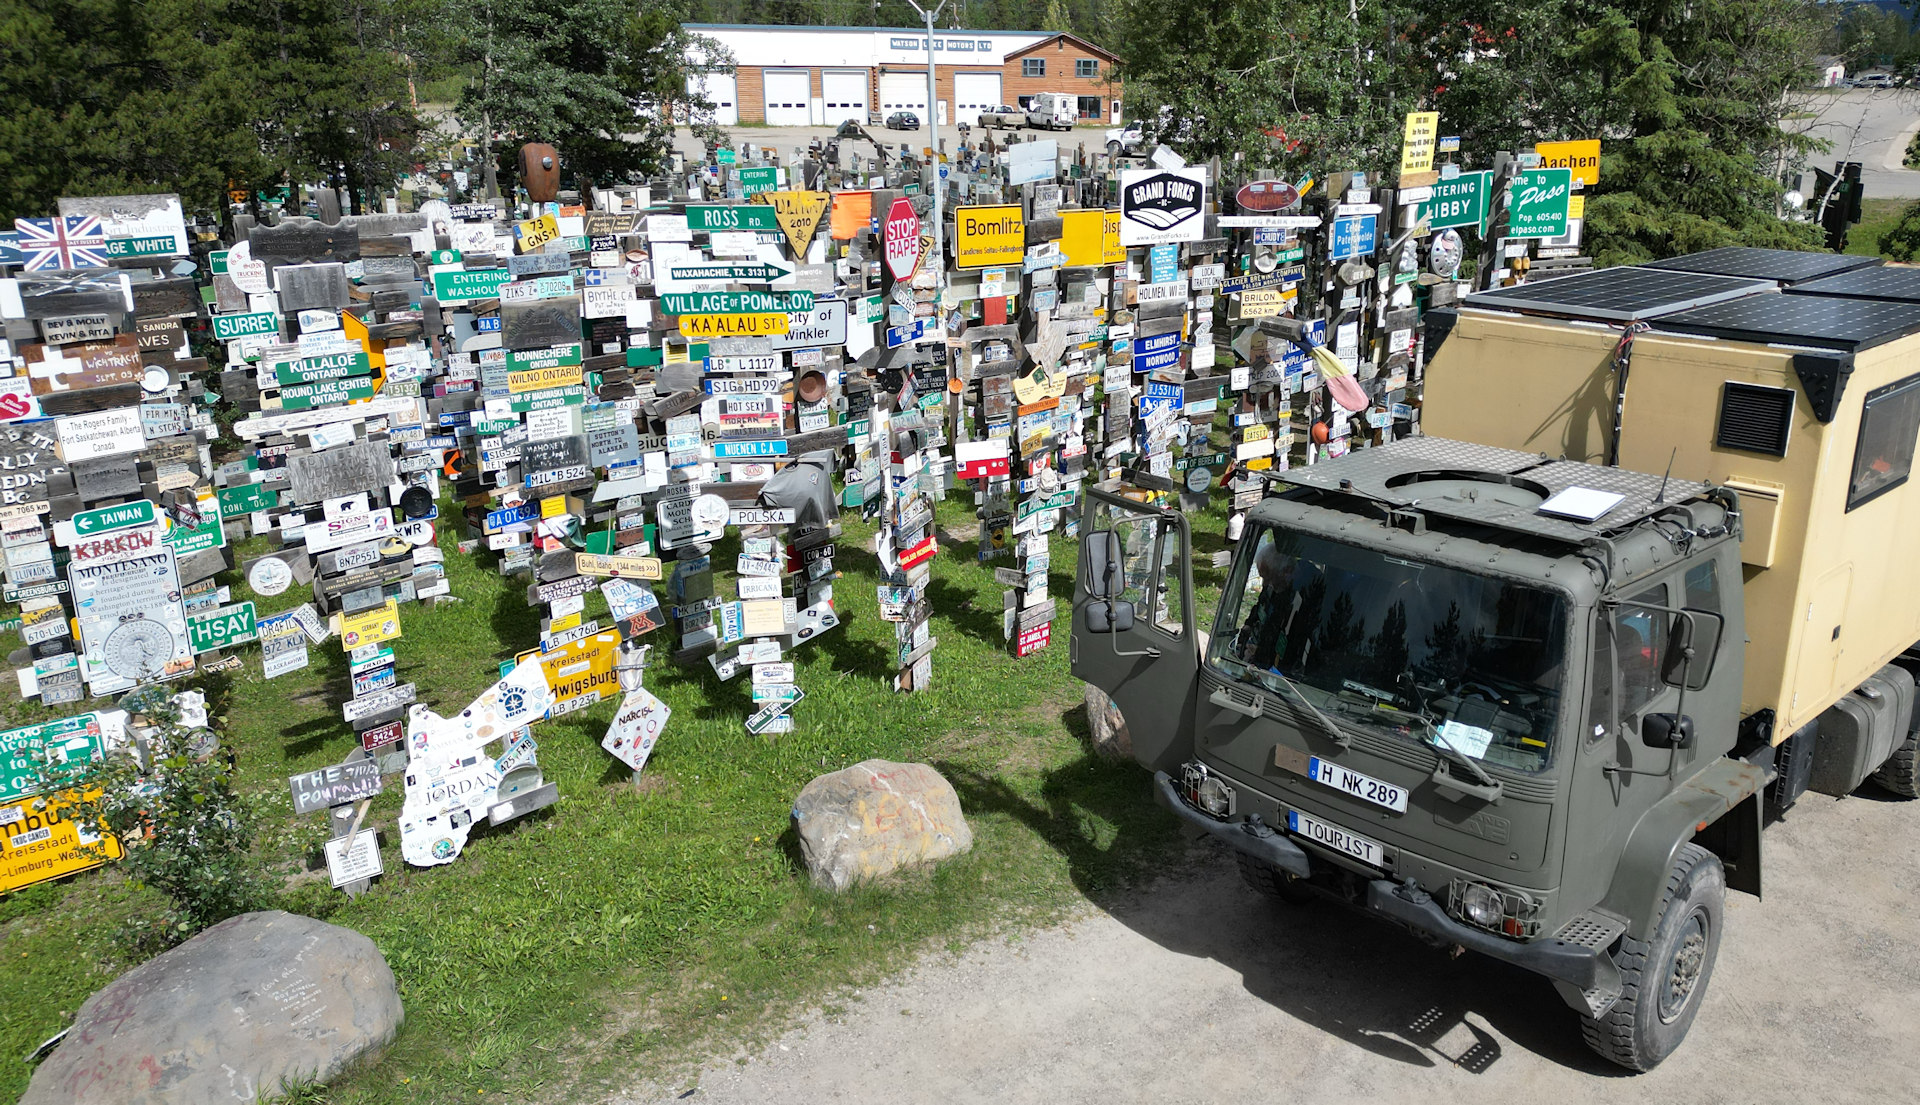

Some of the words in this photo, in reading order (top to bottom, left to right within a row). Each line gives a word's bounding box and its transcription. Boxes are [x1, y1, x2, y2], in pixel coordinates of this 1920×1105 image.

[923, 40, 942, 48] LKE
[947, 41, 973, 49] MOTORS
[1539, 155, 1597, 169] Aachen
[1537, 174, 1546, 184] to
[744, 183, 774, 193] IRKLAND
[1132, 182, 1164, 205] GRAND
[1167, 182, 1195, 203] FORKS
[1518, 183, 1565, 212] Paso
[1426, 200, 1471, 219] LIBBY
[530, 219, 544, 232] 73
[704, 210, 739, 227] ROSS
[749, 218, 763, 227] RD.
[790, 218, 811, 227] 2010
[966, 216, 1022, 236] Bomlitz
[888, 218, 916, 240] STOP
[133, 238, 174, 253] WHITE
[528, 230, 558, 247] GNS-1
[889, 237, 916, 259] RAPE
[453, 273, 510, 284] ENTERING
[673, 268, 733, 278] WAXAHACHIE,
[748, 268, 766, 277] 3131
[768, 268, 778, 276] MI
[1202, 267, 1215, 276] LOCAL
[1223, 277, 1248, 288] GLACIER
[1250, 272, 1275, 283] BREWING
[1277, 267, 1302, 279] COMPANY
[1194, 276, 1211, 287] TRAFFIC
[1139, 286, 1167, 300] HOLMEN,
[1169, 285, 1177, 296] WI
[1244, 294, 1275, 302] BRILON
[665, 296, 730, 313] VILLAGE
[48, 320, 65, 329] DEV
[76, 317, 105, 326] MOLLY
[691, 316, 757, 333] KA'ALAU
[764, 318, 776, 330] ST
[786, 311, 809, 325] City
[819, 309, 833, 321] of
[142, 321, 179, 331] SANDRA
[218, 315, 276, 336] SURREY
[49, 330, 76, 342] KEVIN
[88, 328, 110, 337] RITA
[784, 328, 830, 341] Winkler
[1145, 335, 1176, 350] ELMHIRST
[514, 347, 572, 362] BONNECHERE
[1146, 352, 1175, 367] NORWOOD
[289, 355, 357, 373] KILLALOE
[530, 359, 559, 368] ONTARIO
[710, 358, 724, 370] LB
[748, 358, 774, 369] 1117
[302, 368, 348, 381] ONTARIO
[510, 372, 540, 384] WILNO
[543, 367, 580, 380] ONTARIO
[282, 386, 313, 399] ROUND
[315, 384, 336, 394] LAKE
[338, 378, 372, 392] CENTER
[532, 390, 564, 400] MADAWASKA
[565, 386, 583, 395] VALLEY
[713, 381, 737, 393] SIG
[744, 380, 760, 392] HD
[762, 379, 777, 391] 99
[309, 392, 349, 406] ONTARIO
[531, 398, 565, 409] ONTARIO
[146, 410, 161, 418] FIR
[728, 402, 742, 412] HOT
[746, 402, 764, 412] SEXY
[70, 422, 82, 431] The
[83, 419, 106, 430] Rogers
[107, 416, 128, 427] Family
[478, 422, 510, 433] LUMBY
[62, 435, 74, 444] Fort
[75, 427, 119, 443] Saskatchewan,
[120, 424, 141, 434] Alberta
[595, 430, 625, 439] SUTTON'S
[92, 441, 115, 452] Canada
[592, 440, 611, 448] NORTH
[724, 442, 757, 456] NUENEN
[531, 474, 551, 485] MIL
[557, 470, 563, 480] B
[566, 468, 585, 478] 524
[16, 506, 35, 514] 7065
[100, 507, 143, 525] TAIWAN
[739, 511, 785, 523] POLSKA
[74, 532, 154, 560] KRAKOW
[189, 534, 214, 546] LIMITS
[78, 553, 168, 579] MONTESANO
[581, 558, 596, 569] Buhl,
[597, 558, 612, 569] Idaho
[616, 562, 629, 571] 1344
[630, 563, 646, 573] miles
[110, 572, 149, 584] designated
[95, 586, 124, 596] heritage
[126, 578, 165, 589] community
[611, 582, 632, 597] ROXY
[101, 593, 130, 604] founded
[132, 588, 155, 597] during
[89, 600, 135, 613] Washington's
[678, 607, 689, 617] MK
[362, 622, 379, 632] GERMANY
[547, 637, 560, 649] LB
[565, 630, 579, 642] TK
[580, 623, 597, 637] 760
[264, 642, 281, 655] 972
[288, 636, 305, 647] KLX
[550, 648, 600, 669] Kreisstadt
[552, 669, 618, 698] dwigsburg
[498, 687, 527, 703] EARTH
[505, 707, 527, 719] IRON
[553, 703, 566, 715] LB
[372, 729, 394, 743] 9424
[499, 756, 515, 773] 425
[517, 739, 533, 755] FMB
[9, 759, 27, 770] to
[292, 768, 341, 792] THE
[425, 769, 498, 806] JORDAN
[1322, 764, 1333, 783] H
[1342, 770, 1363, 795] NK
[1367, 781, 1399, 806] 289
[1304, 819, 1374, 860] TOURIST
